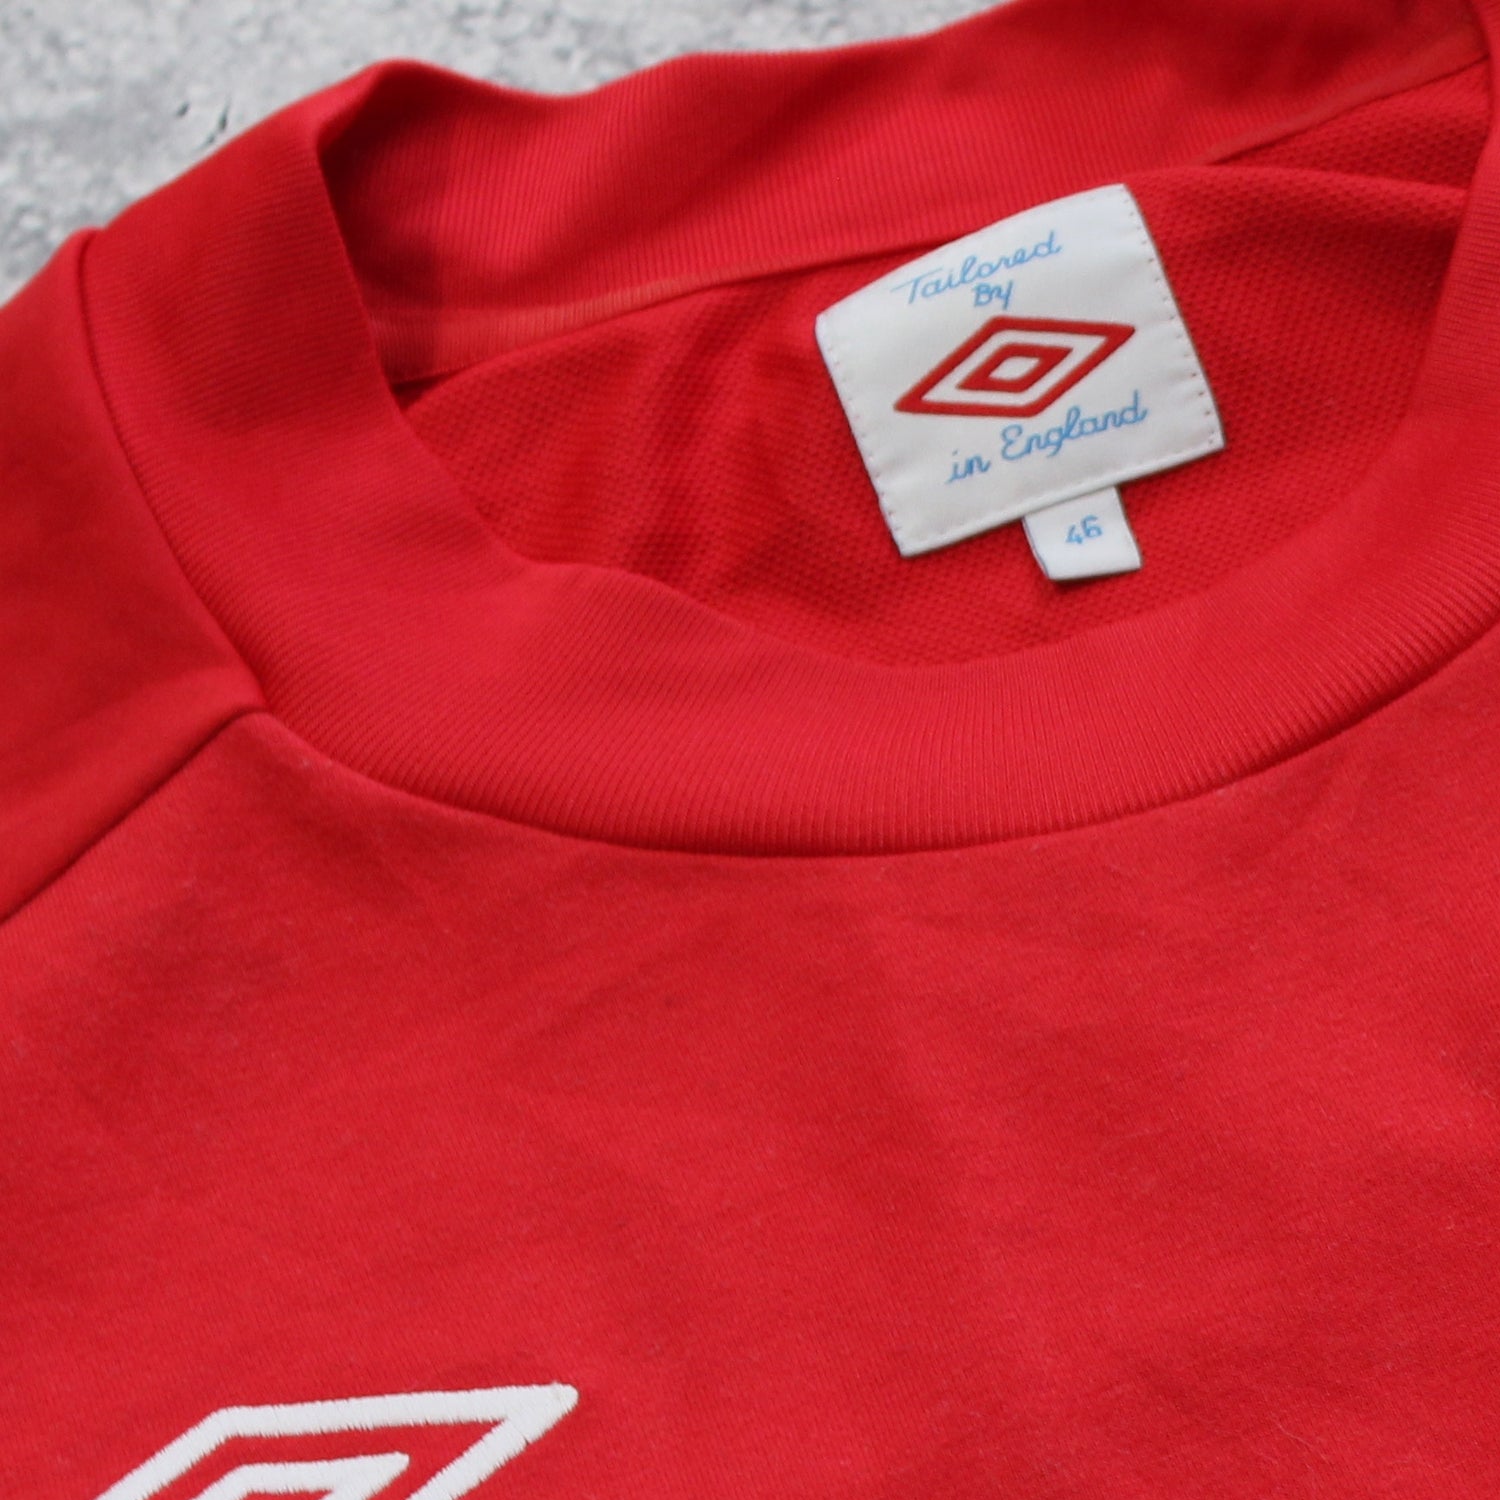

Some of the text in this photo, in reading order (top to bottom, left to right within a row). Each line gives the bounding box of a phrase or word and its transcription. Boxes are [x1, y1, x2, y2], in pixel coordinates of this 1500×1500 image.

[890, 230, 1063, 304] Tailored
[946, 389, 1148, 484] in England
[1065, 514, 1103, 545] 46
